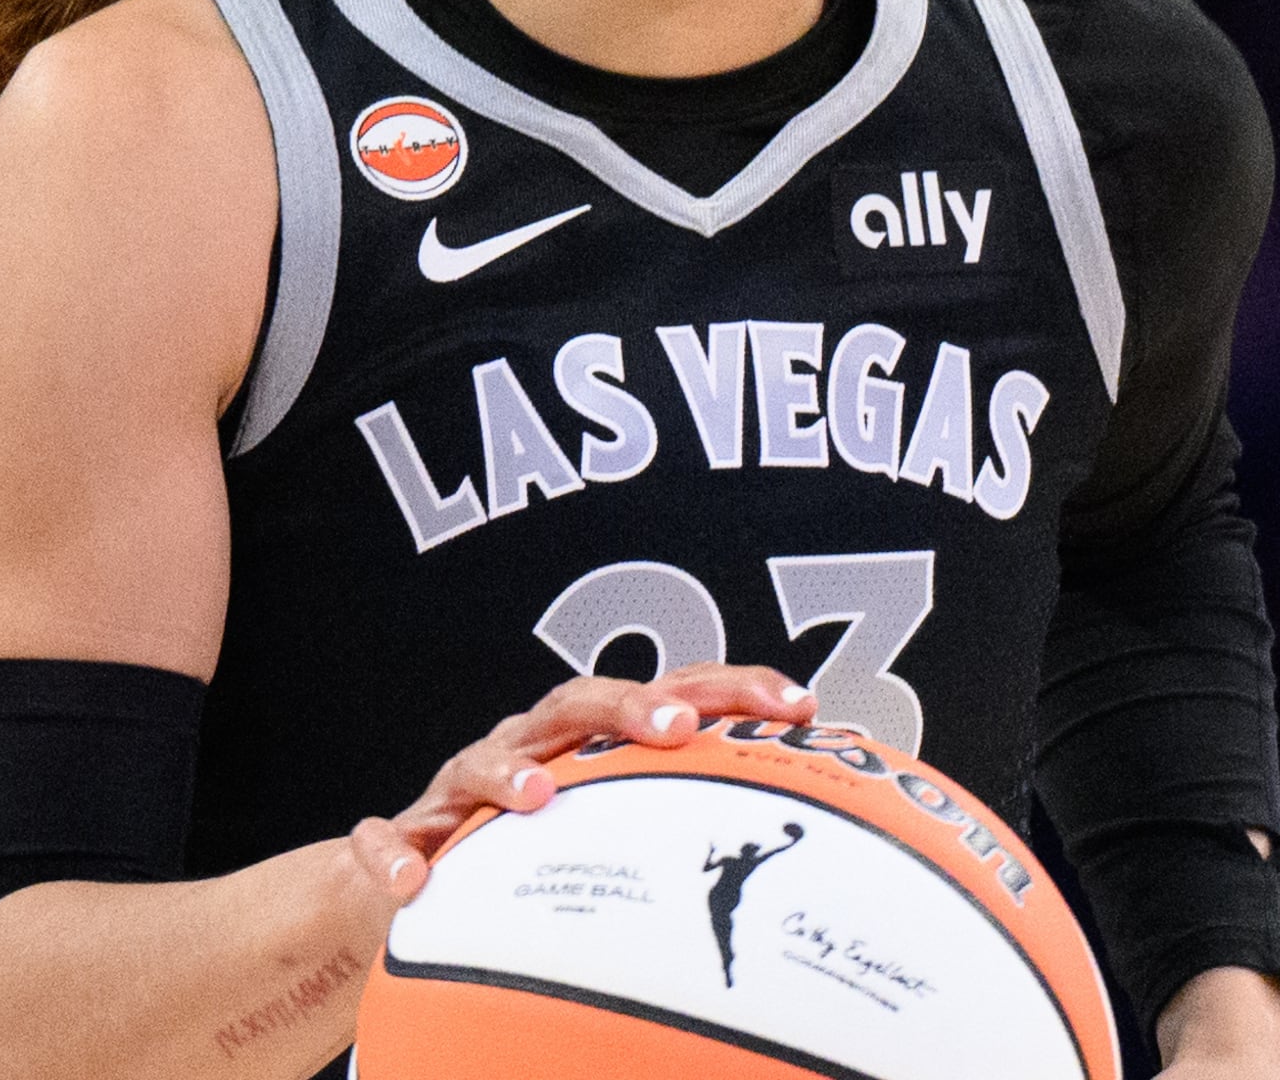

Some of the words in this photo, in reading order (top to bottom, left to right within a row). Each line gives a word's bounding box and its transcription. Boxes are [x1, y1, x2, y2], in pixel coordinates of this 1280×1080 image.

[850, 170, 992, 264] ally
[354, 332, 658, 553] LAS
[656, 320, 1050, 520] VEGAS
[532, 550, 936, 760] 23
[513, 882, 585, 898] GAME
[590, 884, 656, 904] BALL
[536, 863, 645, 881] OFFICIAL
